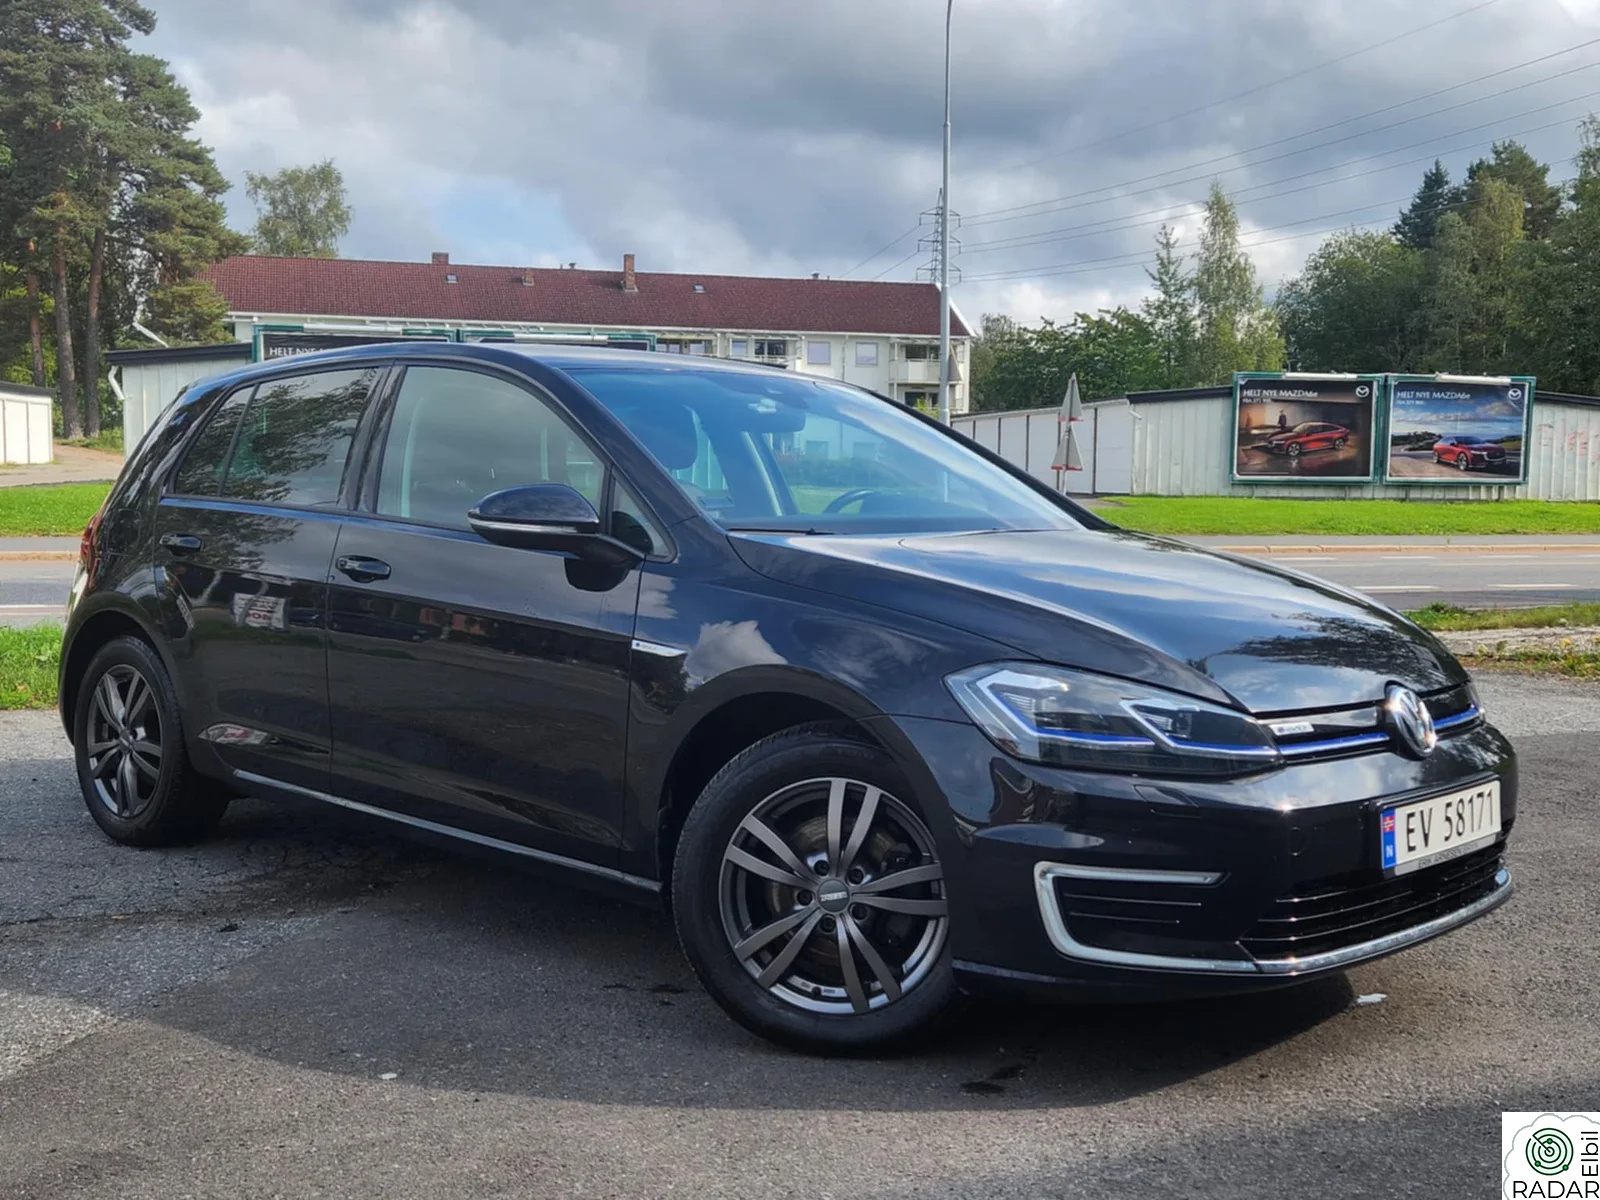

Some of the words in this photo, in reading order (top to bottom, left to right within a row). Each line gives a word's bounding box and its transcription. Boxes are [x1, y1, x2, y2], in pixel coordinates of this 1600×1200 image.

[269, 347, 294, 357] HELT
[1243, 389, 1261, 397] HELT
[1262, 389, 1278, 397] NYE
[1397, 391, 1415, 399] HELT
[1416, 391, 1430, 399] NYE
[1406, 807, 1433, 853] EV
[1444, 789, 1493, 842] 58171
[1386, 844, 1394, 858] N
